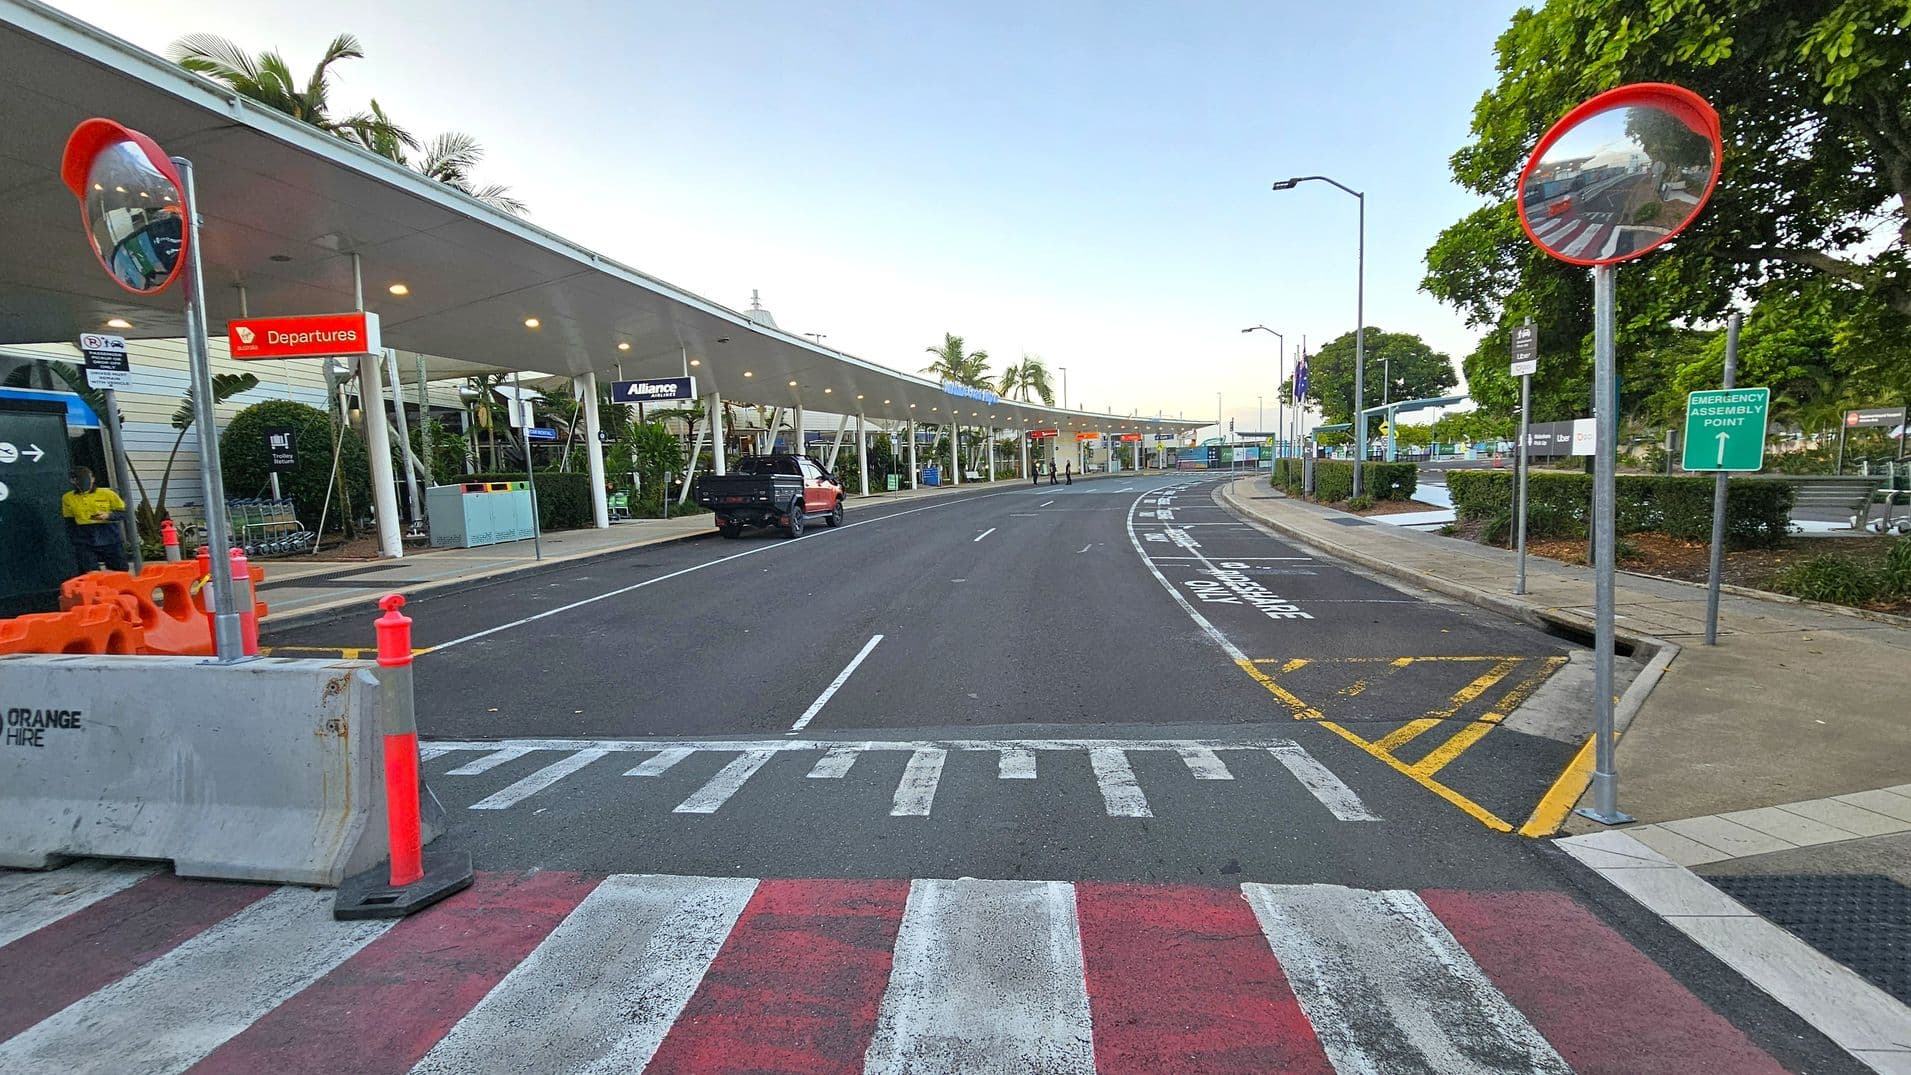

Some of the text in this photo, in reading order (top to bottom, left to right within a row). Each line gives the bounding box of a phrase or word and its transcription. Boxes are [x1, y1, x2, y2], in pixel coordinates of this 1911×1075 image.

[267, 330, 356, 346] Departures
[627, 383, 677, 395] Alliance
[1691, 393, 1765, 405] EMERGENCY
[1691, 405, 1763, 416] ASSEMBLY
[1704, 418, 1744, 427] POINT
[1557, 434, 1570, 442] Uber
[1184, 580, 1243, 604] ONLY
[1208, 570, 1315, 619] RIDESHARE
[8, 708, 82, 728] ORANGE
[6, 728, 45, 747] HIRE
